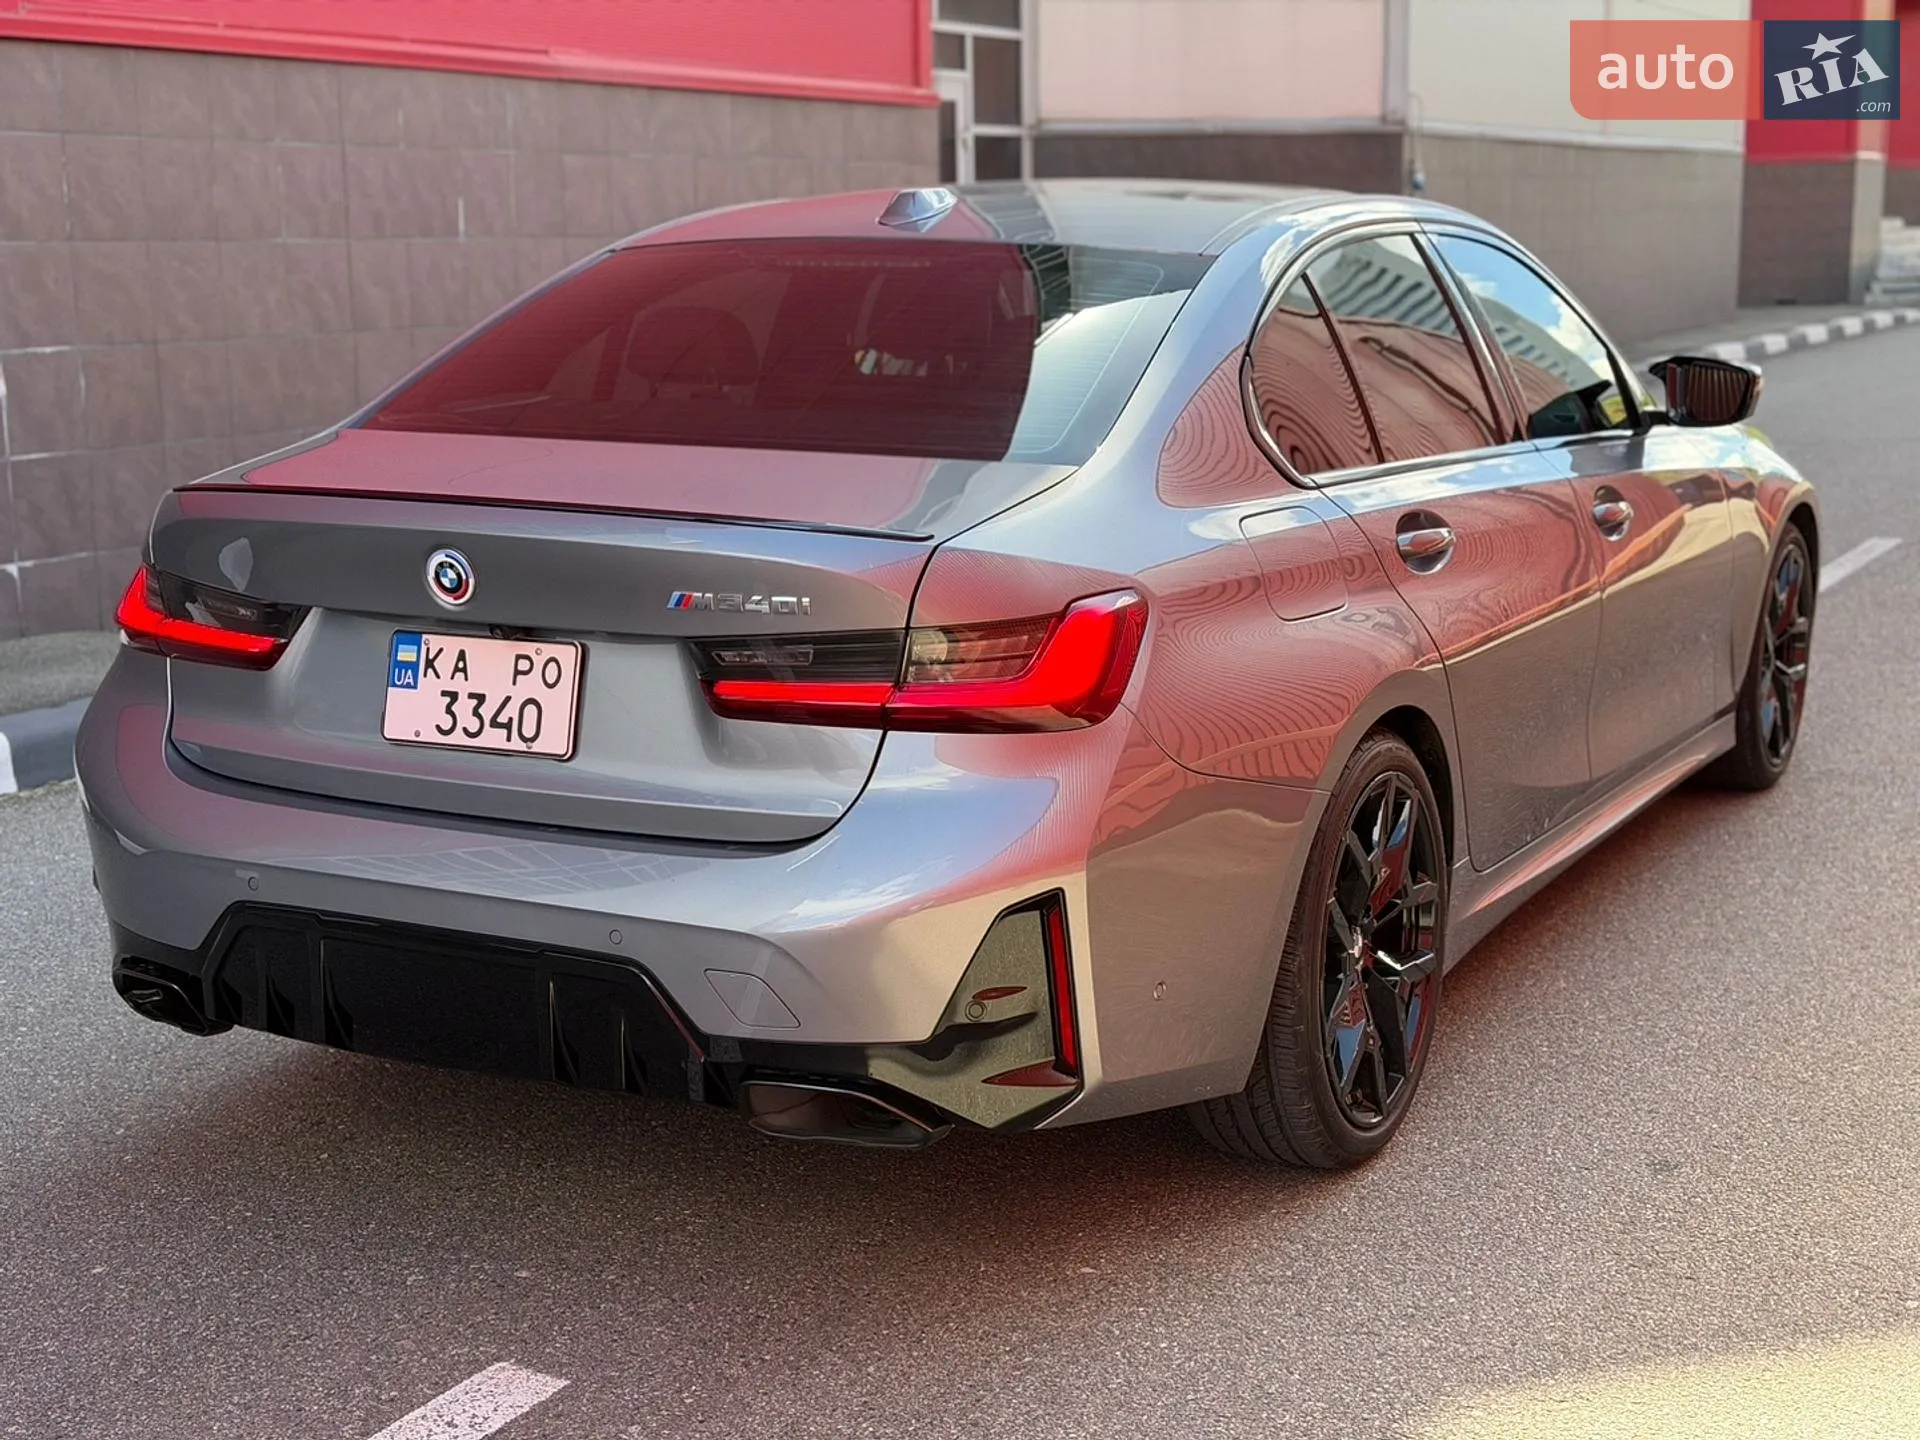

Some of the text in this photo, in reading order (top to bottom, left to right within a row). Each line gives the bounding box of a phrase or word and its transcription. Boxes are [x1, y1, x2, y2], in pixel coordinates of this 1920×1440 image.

[394, 668, 415, 686] UA
[423, 646, 562, 689] KA PO
[435, 689, 543, 744] 3340
